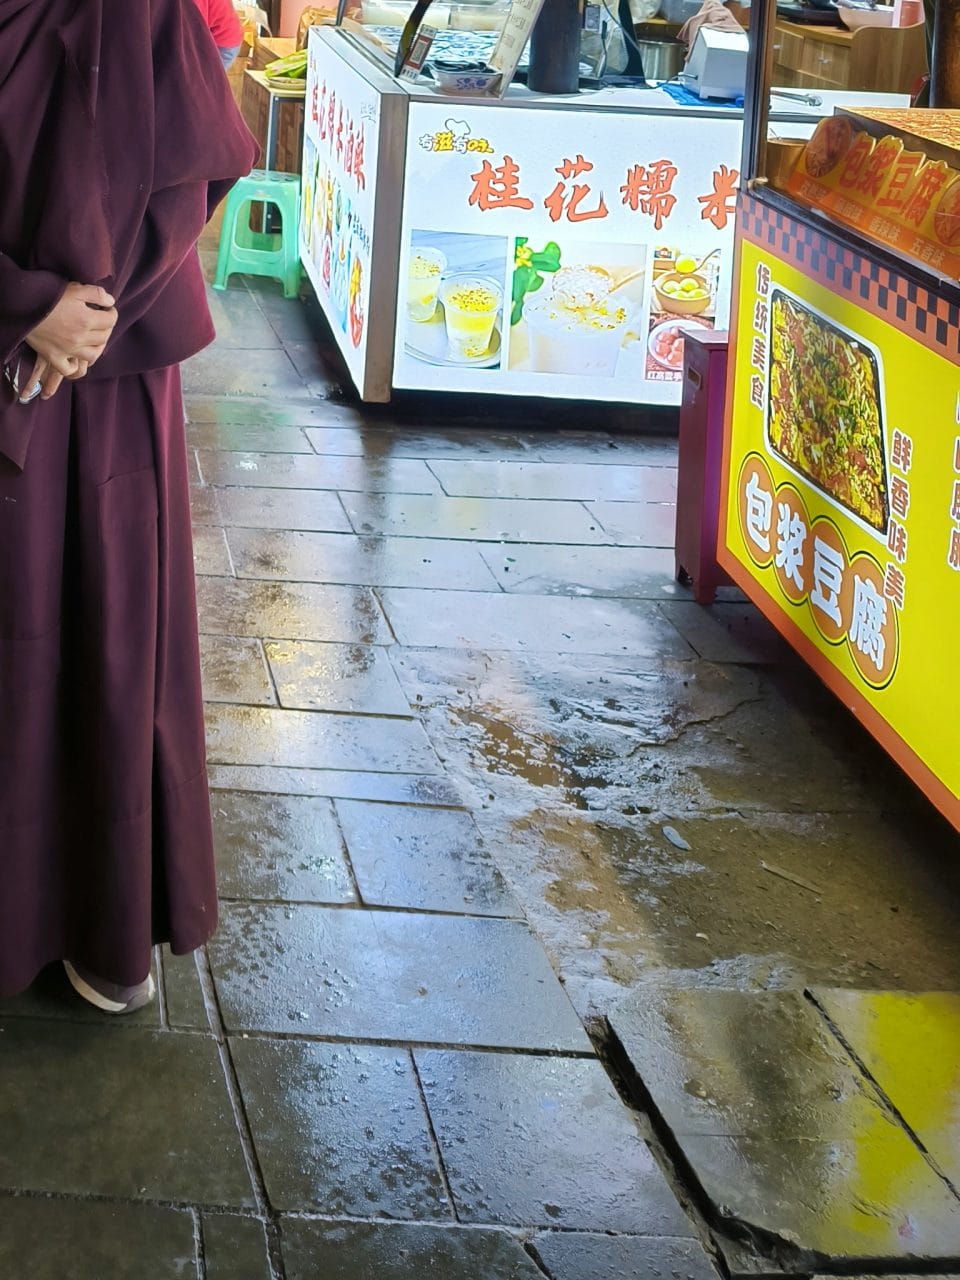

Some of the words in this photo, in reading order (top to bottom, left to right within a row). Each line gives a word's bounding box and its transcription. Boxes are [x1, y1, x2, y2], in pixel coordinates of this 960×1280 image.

[468, 155, 737, 230] 桂花糯米
[751, 263, 770, 409] 传统美食
[745, 471, 887, 671] 包浆豆腐
[884, 428, 912, 610] 鲜香味美
